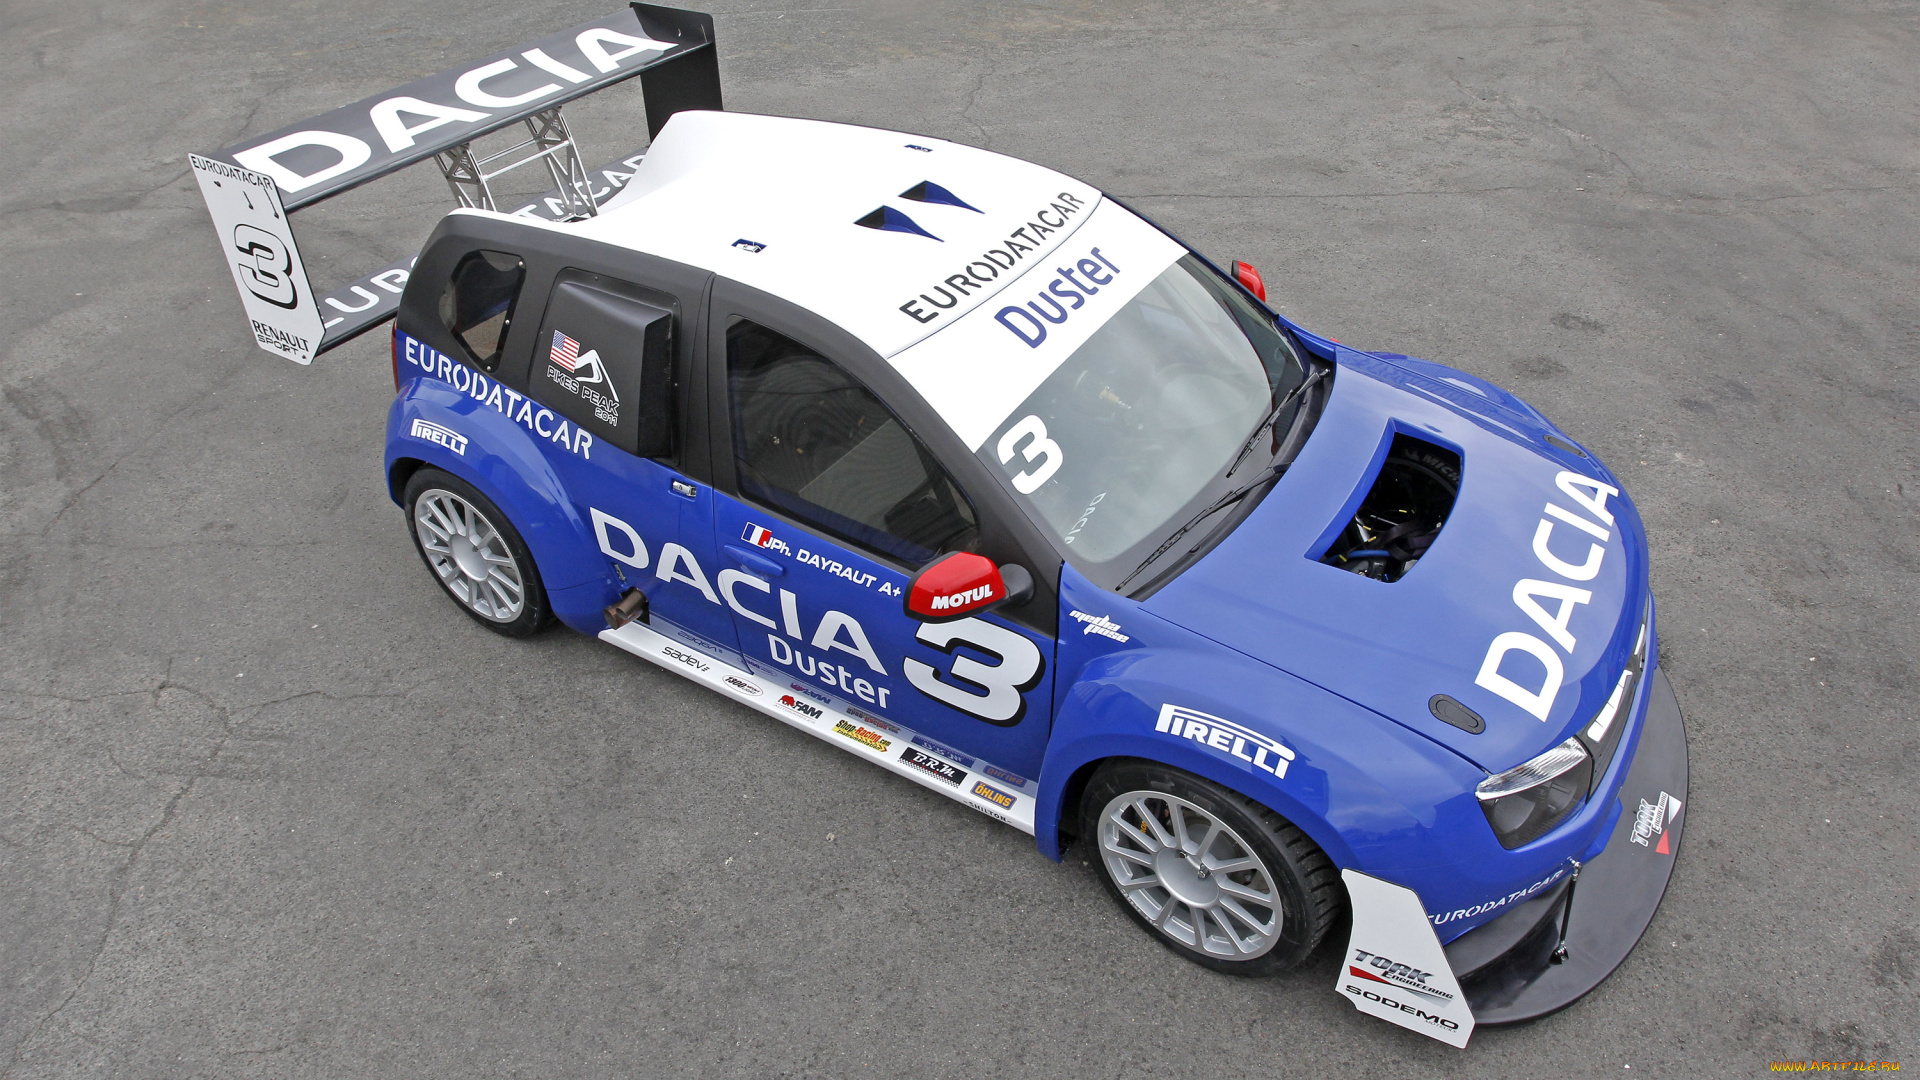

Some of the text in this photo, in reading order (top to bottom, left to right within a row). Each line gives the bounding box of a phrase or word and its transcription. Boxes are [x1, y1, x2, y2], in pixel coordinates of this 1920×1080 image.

[232, 27, 679, 194] DACIA
[190, 155, 273, 191] EURODATACAR
[234, 224, 298, 310] 3
[899, 192, 1085, 324] EURODATACAR
[994, 246, 1121, 349] Duster
[252, 319, 309, 353] RENAULT
[257, 334, 299, 356] SPORT
[405, 336, 593, 460] EURODATACAR
[547, 365, 620, 417] PIKES PEAK
[595, 406, 618, 427] 2011
[410, 418, 469, 457] PIRELLI
[996, 414, 1064, 495] 3
[590, 506, 888, 676] DACIA
[762, 534, 901, 598] JPh. DAYRAUT A+
[931, 584, 993, 610] MOTUL
[1474, 470, 1619, 723] DACIA
[662, 646, 707, 670] sadev
[767, 633, 891, 709] Duster
[903, 616, 1045, 727] 3
[792, 701, 824, 719] FAM
[1154, 703, 1296, 780] PIRELLI
[975, 783, 1013, 808] ÖHLINS
[1630, 798, 1658, 847] TORK
[1355, 948, 1434, 984] TORK
[1345, 984, 1459, 1030] SODEMO
